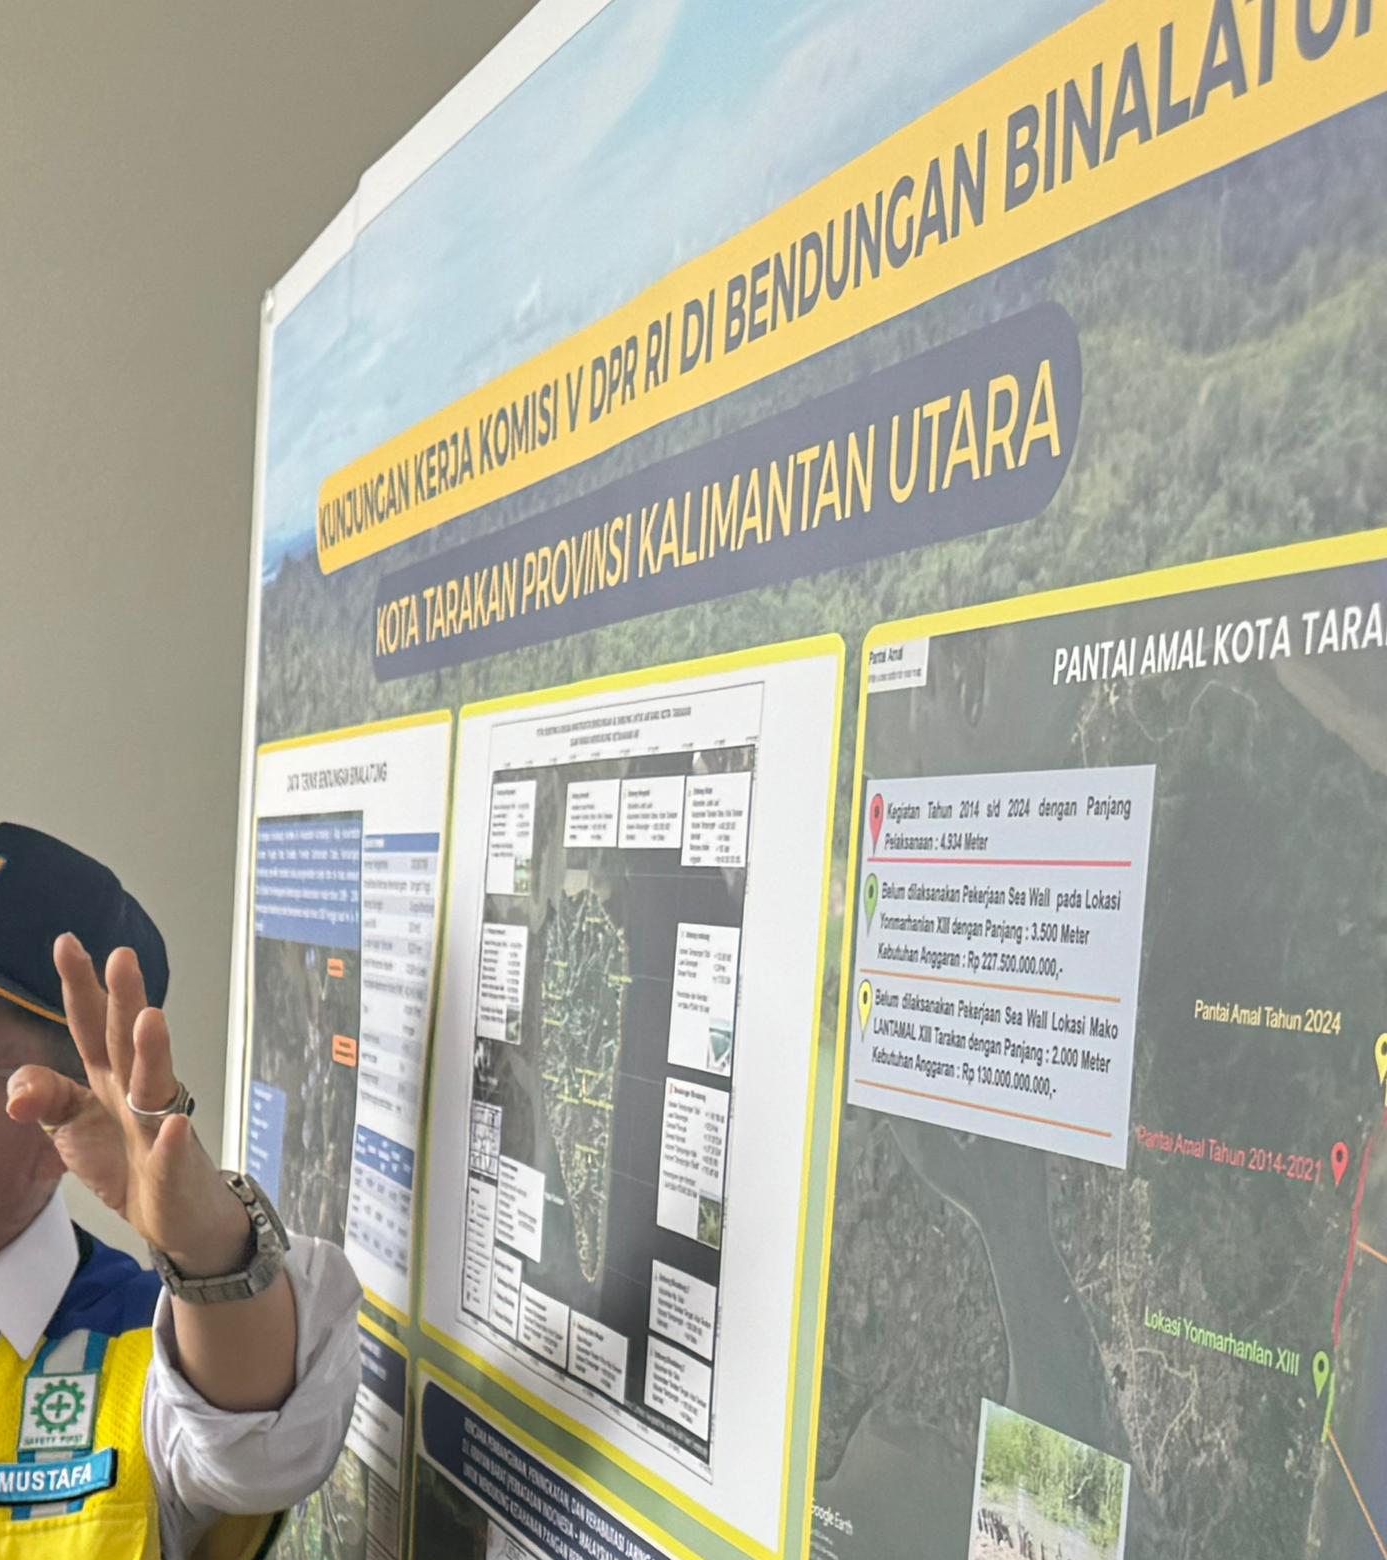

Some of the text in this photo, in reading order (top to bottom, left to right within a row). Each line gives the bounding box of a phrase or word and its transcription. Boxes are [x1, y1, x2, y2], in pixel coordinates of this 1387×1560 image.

[319, 129, 987, 552] KUNJUNGAN KERJA KOMISI V DPR RI DI BENDUNGAN
[376, 358, 1061, 657] KOTA TARAKAN PROVINSI KALIMANTAN UTARA
[1052, 602, 1387, 686] PANTAI AMAL KOTA TARA
[887, 796, 1131, 825] Kegiatan Tahun 2014 s/d 2024 dengan Panjang
[964, 833, 988, 851] Meter
[882, 882, 1121, 912] Belum dilaksanakan Pekerjaan Sea Wall pada Lokasi
[951, 917, 983, 940] dengan
[985, 919, 1023, 944] Panjang
[1031, 922, 1058, 943] 3.500
[1060, 923, 1090, 945] Meter
[877, 942, 919, 963] Kebutuhan
[920, 946, 961, 970] Anggaran
[967, 950, 980, 973] Rp
[875, 988, 1118, 1040] Belum dilaksanakan Pekerjaan Sea Wall Lokasi Mako
[1194, 999, 1341, 1035] Pantai Amal Tahun 2024
[871, 1046, 914, 1070] Kebutuhan
[914, 1053, 955, 1078] Anggaran
[961, 1061, 975, 1085] Rp
[874, 1018, 916, 1040] LANTAMAL
[934, 1027, 966, 1049] Tarakan
[967, 1033, 1001, 1057] dengan
[1004, 1038, 1044, 1065] Panjang
[1052, 1045, 1078, 1068] 2.000
[1081, 1049, 1111, 1074] Meter
[1136, 1125, 1323, 1184] Pantai Amal Tahun 2014-2021
[1145, 1305, 1300, 1376] Lokasi Yonmarhanlan XIII
